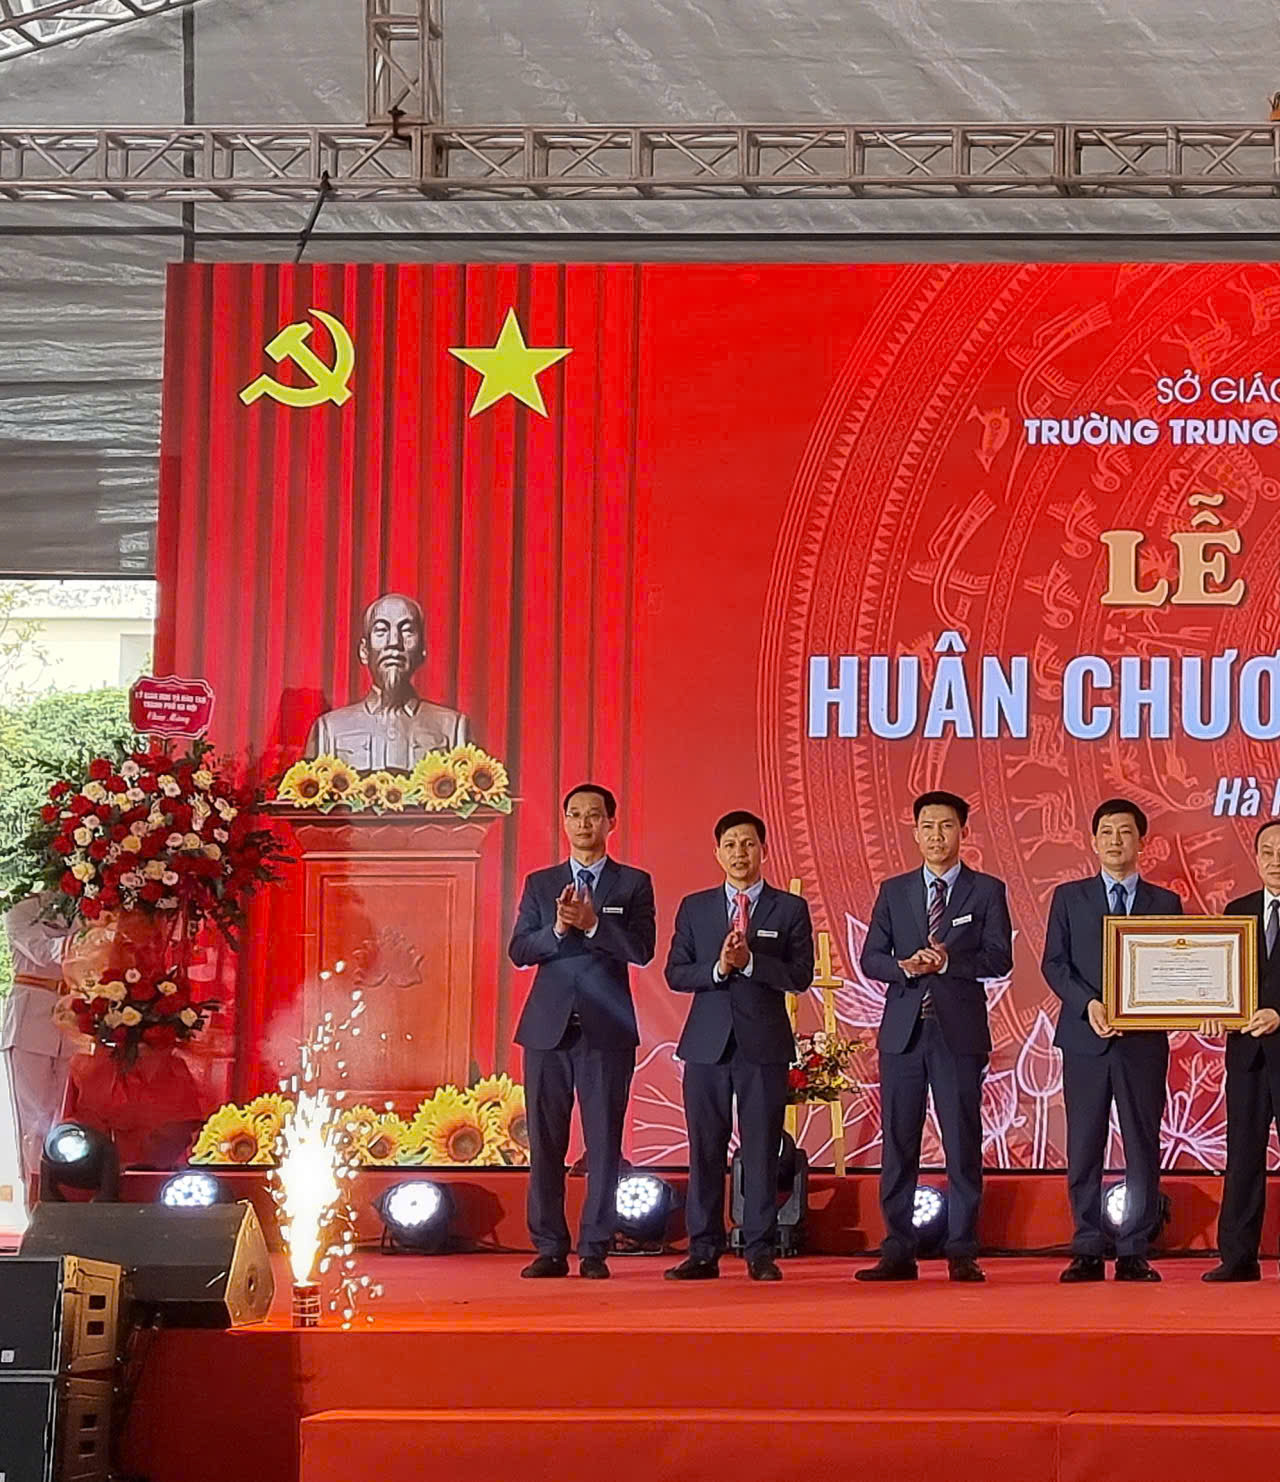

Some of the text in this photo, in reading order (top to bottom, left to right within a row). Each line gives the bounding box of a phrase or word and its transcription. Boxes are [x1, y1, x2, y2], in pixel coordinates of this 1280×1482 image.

[1156, 369, 1200, 403] SỞ
[1024, 412, 1158, 445] TRƯỜNG
[1169, 419, 1278, 445] TRUNG
[1099, 492, 1248, 608] LỄ
[807, 630, 1030, 740] HUÂN
[1213, 777, 1260, 816] Hà
